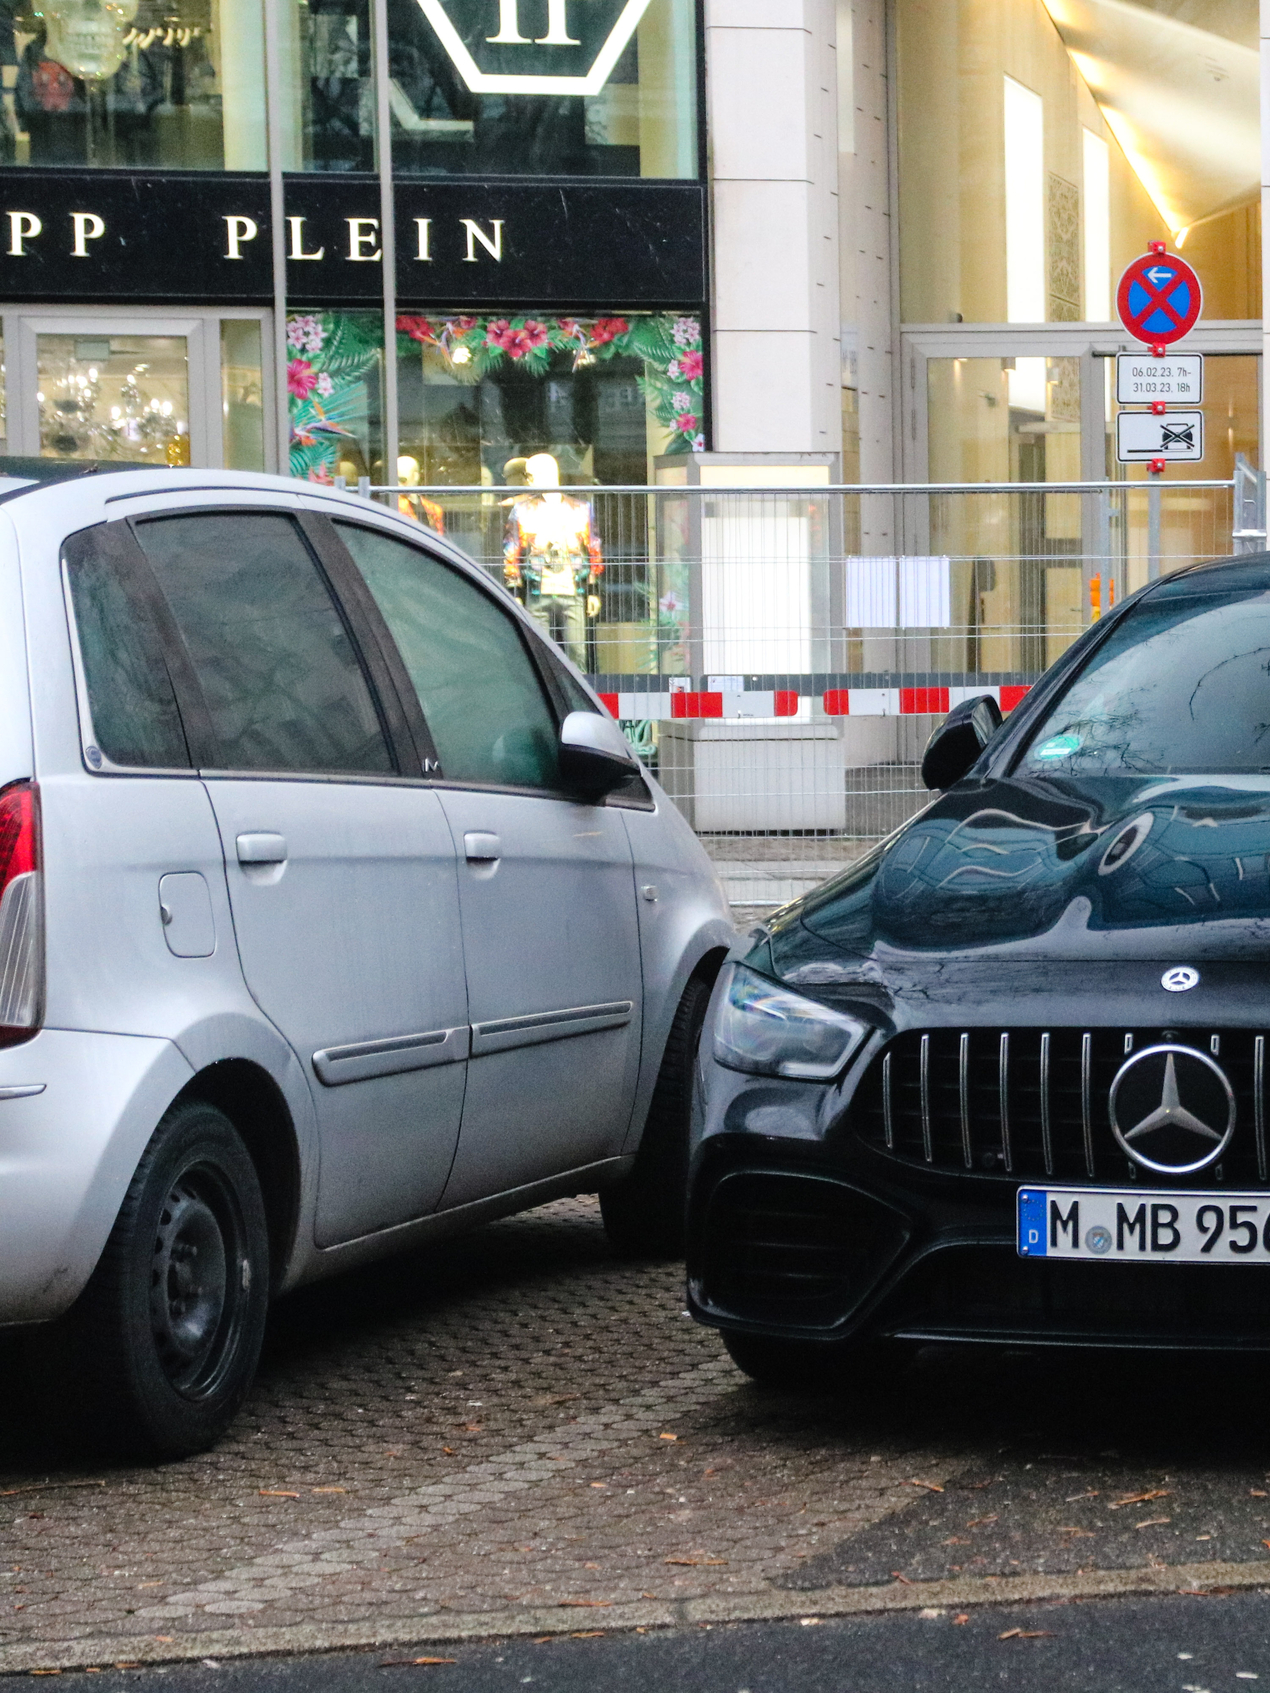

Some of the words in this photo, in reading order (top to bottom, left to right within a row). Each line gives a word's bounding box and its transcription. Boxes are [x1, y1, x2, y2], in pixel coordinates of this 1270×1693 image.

[221, 215, 505, 262] PLEIN
[1132, 366, 1174, 377] 06.02.23.
[1133, 382, 1173, 393] 31.03.23.
[1177, 382, 1191, 393] 18h
[1050, 1200, 1079, 1249] M
[1116, 1202, 1182, 1252] MB
[1028, 1230, 1039, 1244] D
